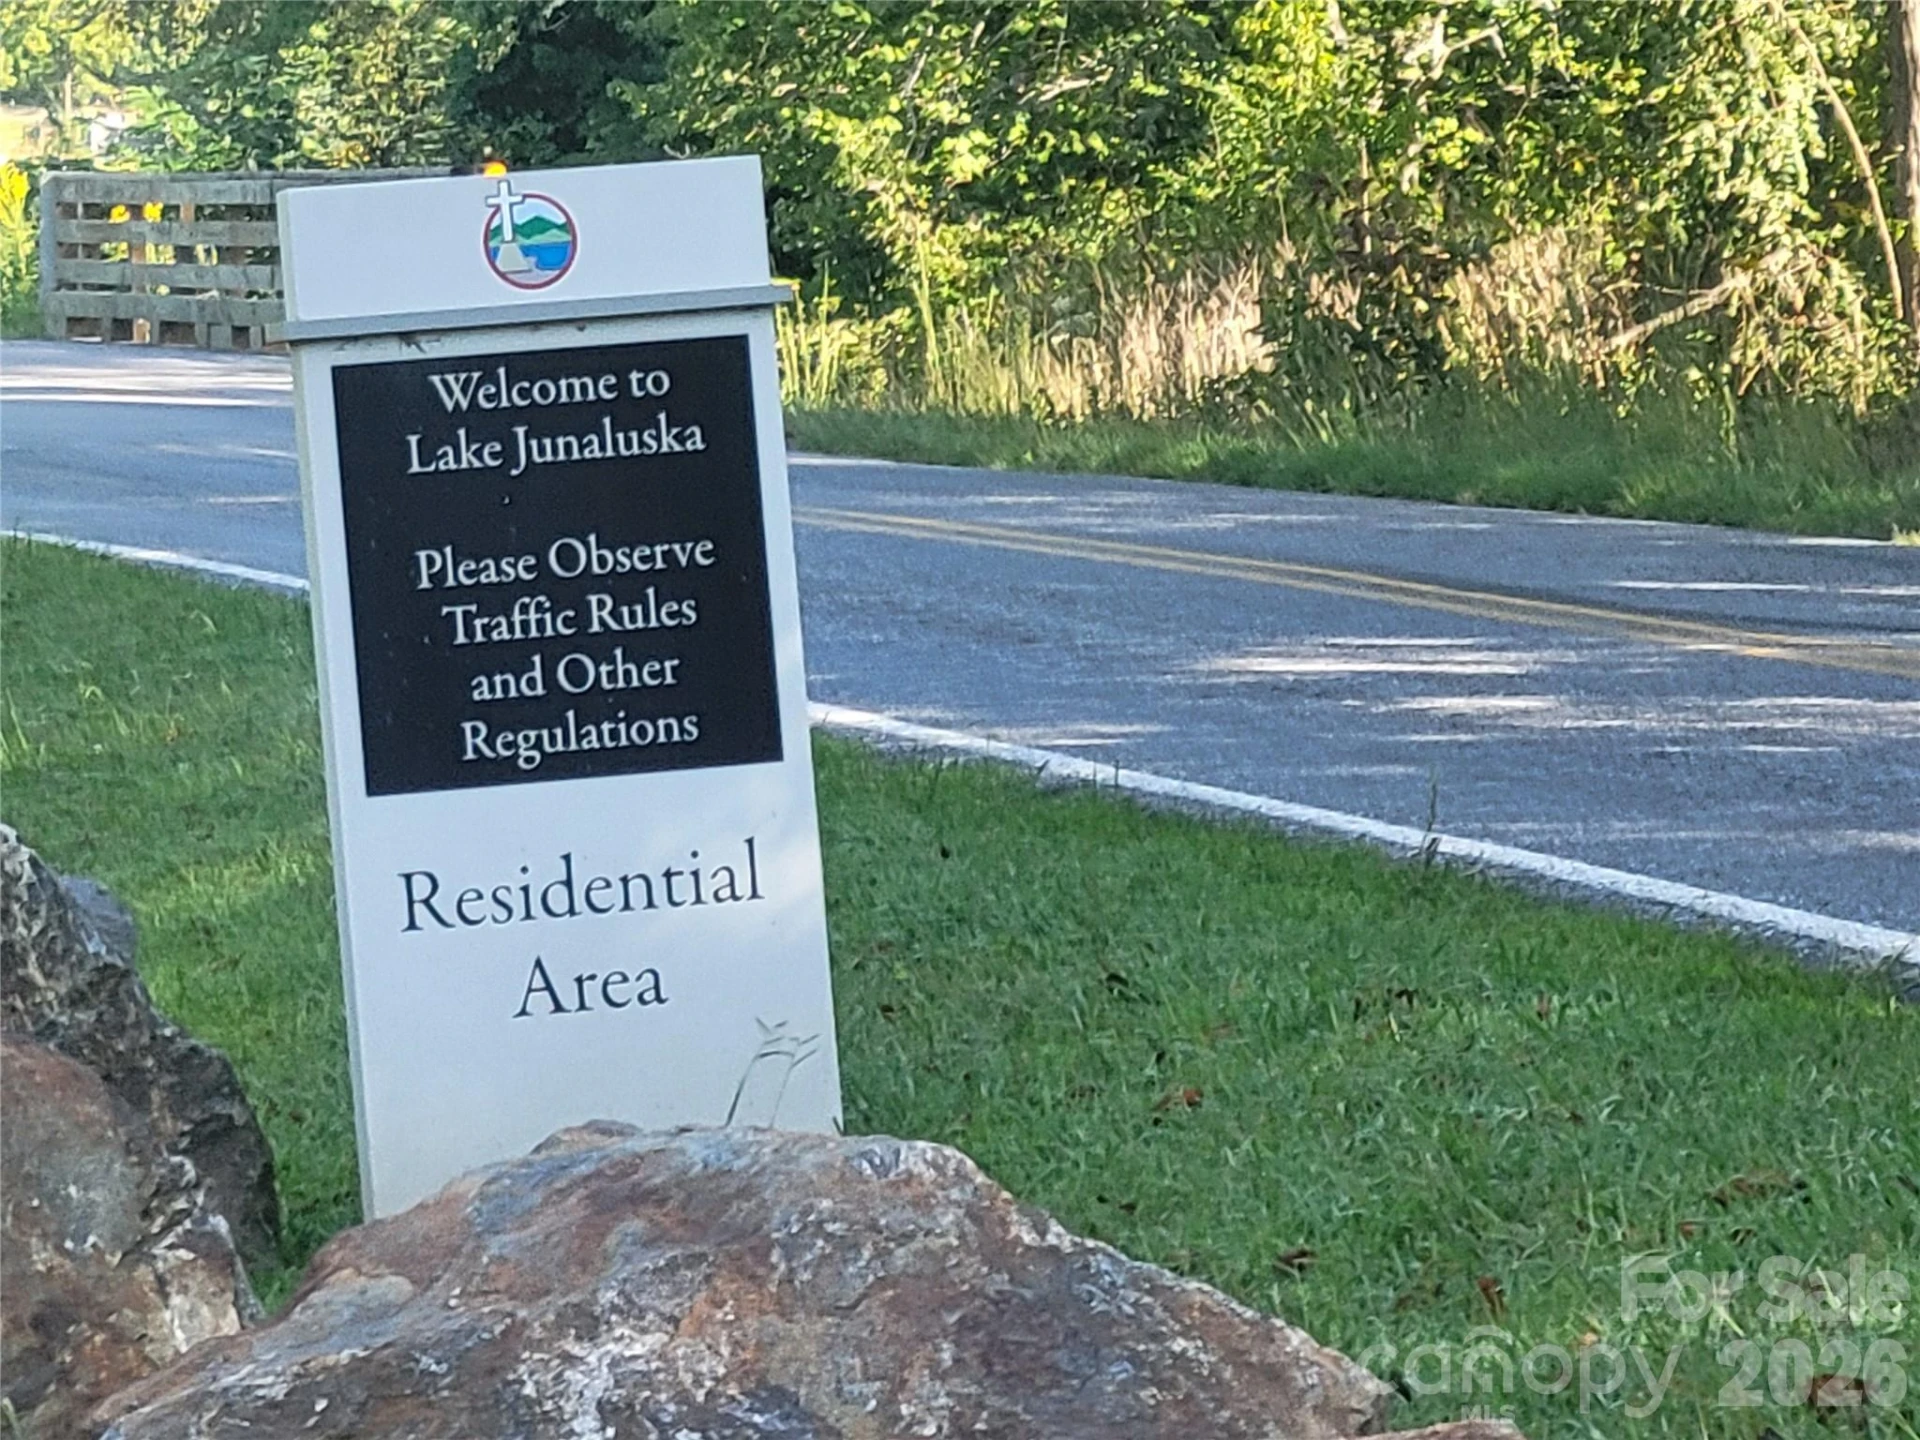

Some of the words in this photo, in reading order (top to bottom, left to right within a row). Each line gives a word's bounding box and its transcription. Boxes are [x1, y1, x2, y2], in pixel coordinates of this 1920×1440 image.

[428, 366, 619, 412] Welcome
[629, 369, 671, 397] to
[406, 427, 504, 474] Lake
[510, 411, 706, 476] Junaluska
[415, 545, 538, 590] Please
[548, 533, 716, 579] Observe
[441, 595, 577, 645] Traffic
[587, 586, 697, 634] Rules
[470, 654, 546, 701] and
[556, 647, 680, 694] Other
[460, 709, 699, 770] Regulations
[397, 836, 765, 933] Residential
[512, 955, 669, 1019] Area
